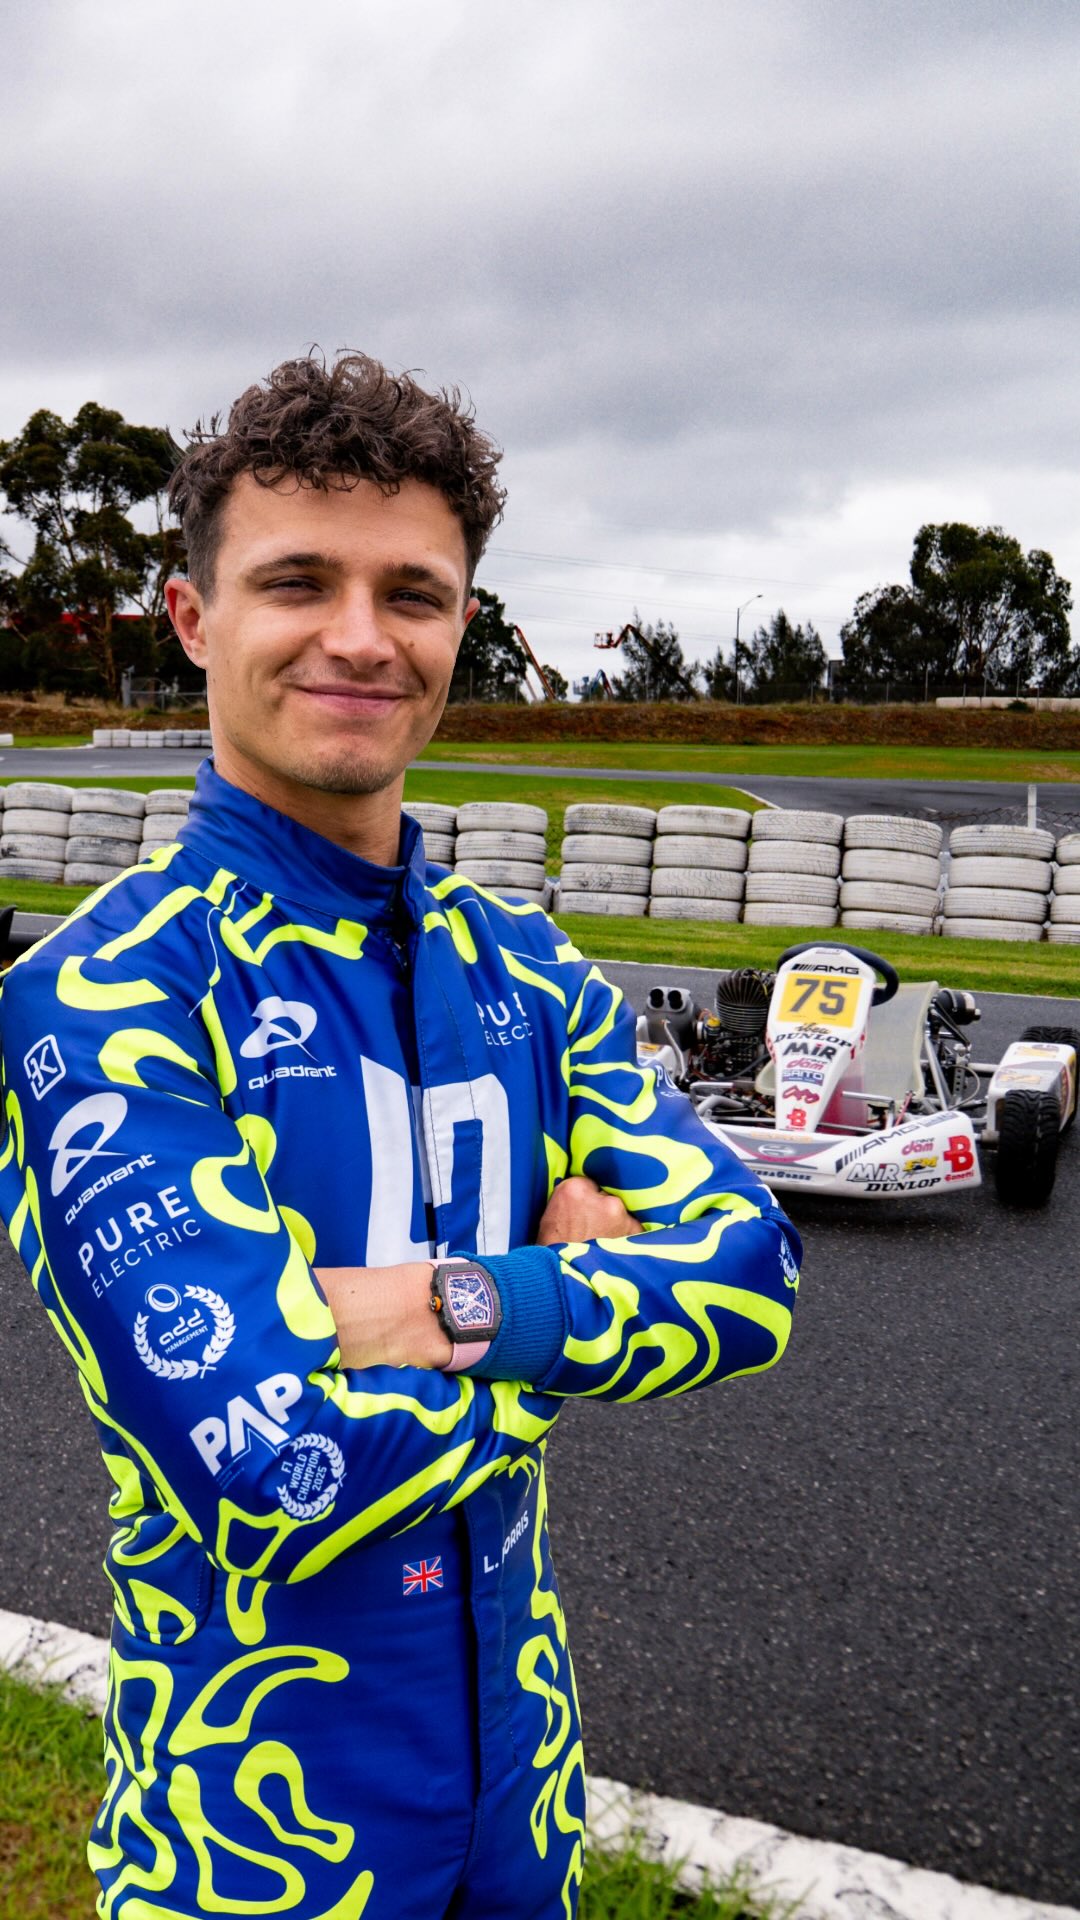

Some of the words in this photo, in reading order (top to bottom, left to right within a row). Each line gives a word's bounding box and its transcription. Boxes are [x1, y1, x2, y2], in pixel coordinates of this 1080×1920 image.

[789, 978, 848, 1016] 75
[774, 1033, 853, 1047] DUNLOP
[248, 1064, 338, 1090] quadrant
[64, 1153, 156, 1225] quadrant
[864, 1177, 941, 1192] DUNLOP
[77, 1185, 191, 1277] PURE
[91, 1218, 202, 1299] ELECTRIC
[164, 1325, 209, 1355] MANAGEMENT
[289, 1453, 308, 1489] WORLD
[296, 1449, 321, 1502] CHAMPION
[311, 1465, 328, 1492] 2025
[483, 1555, 500, 1574] L.
